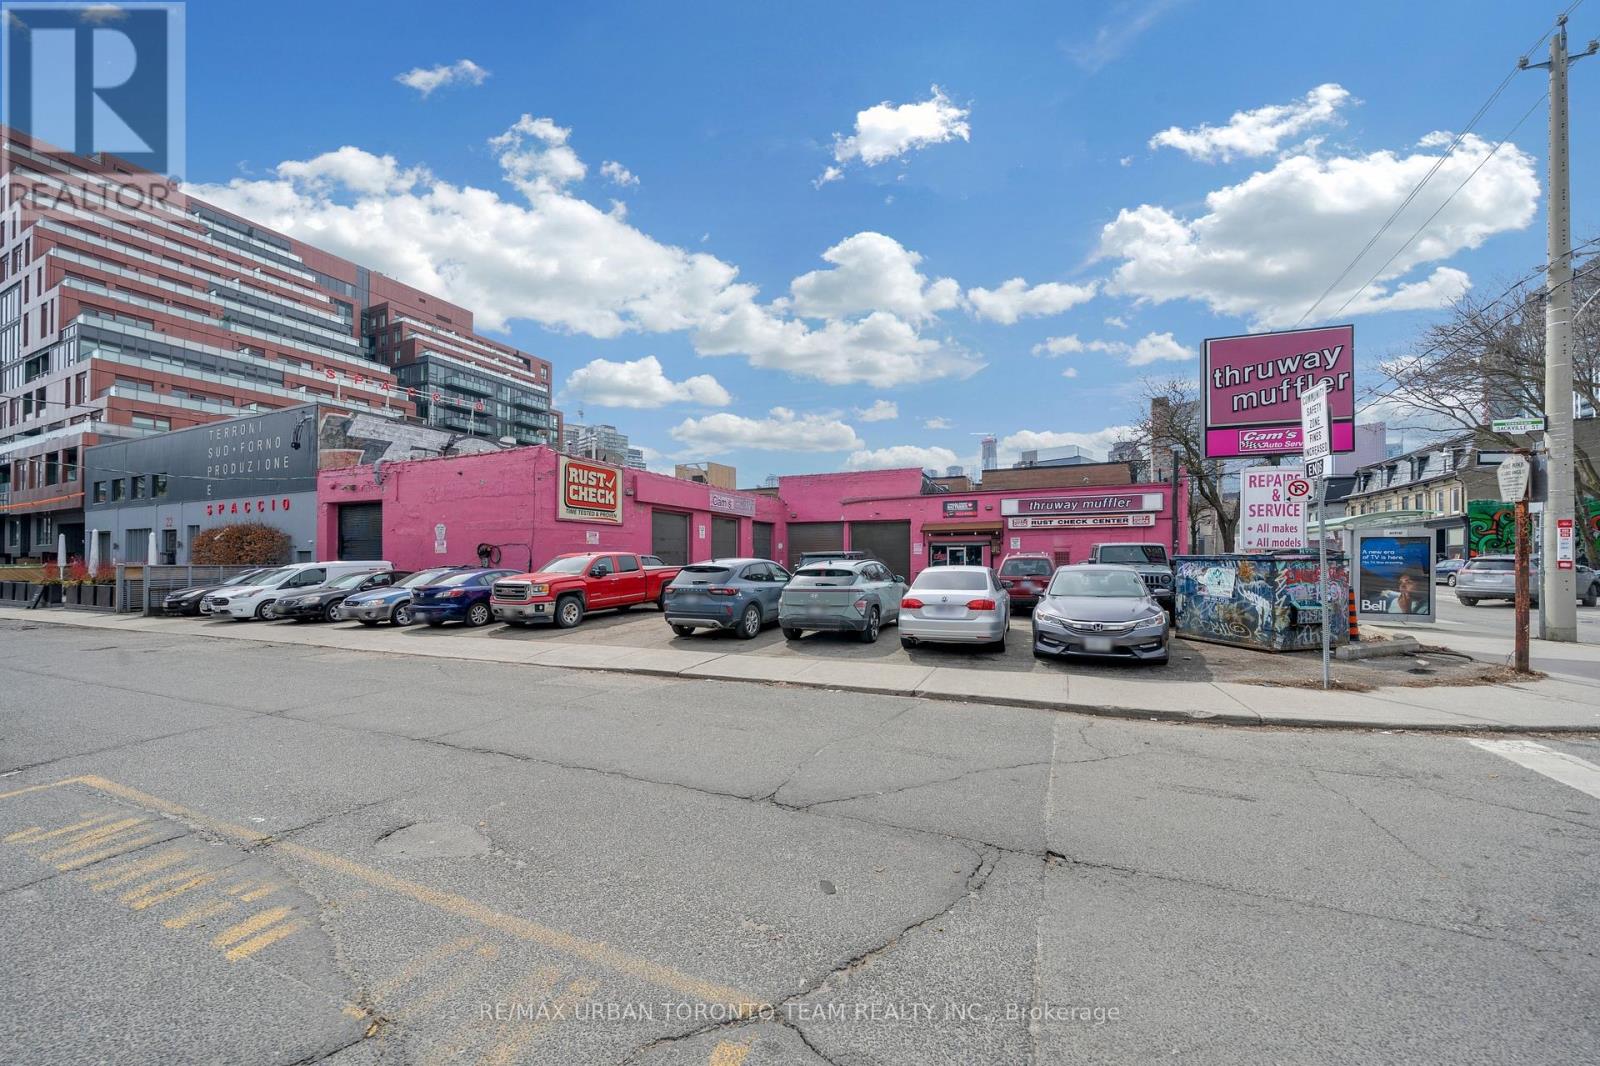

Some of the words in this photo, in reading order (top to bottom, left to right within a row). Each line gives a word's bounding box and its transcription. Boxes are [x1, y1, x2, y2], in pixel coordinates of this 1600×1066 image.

[1213, 344, 1345, 390] thruway
[1232, 371, 1350, 413] muffler
[1306, 402, 1322, 416] SAFETY
[1309, 416, 1321, 429] ZONE
[209, 420, 263, 441] TERRONI
[1243, 430, 1298, 441] Cam's
[1284, 440, 1304, 448] Serv
[1309, 431, 1322, 444] FINES
[207, 456, 290, 477] PRODUZIONE
[568, 467, 607, 488] RUST
[206, 484, 212, 496] E
[569, 485, 615, 505] CHECK
[1272, 488, 1280, 502] &
[207, 498, 290, 516] SPACCIO
[1029, 499, 1078, 511] thruway
[1082, 498, 1132, 509] muffler
[1248, 503, 1300, 518] SERVICE
[578, 509, 596, 517] TESTED
[1092, 517, 1129, 525] CENTER
[1256, 523, 1270, 533] All
[1272, 523, 1298, 533] makes
[1256, 537, 1270, 547] All
[1272, 537, 1302, 548] models
[1361, 600, 1387, 611] Bell
